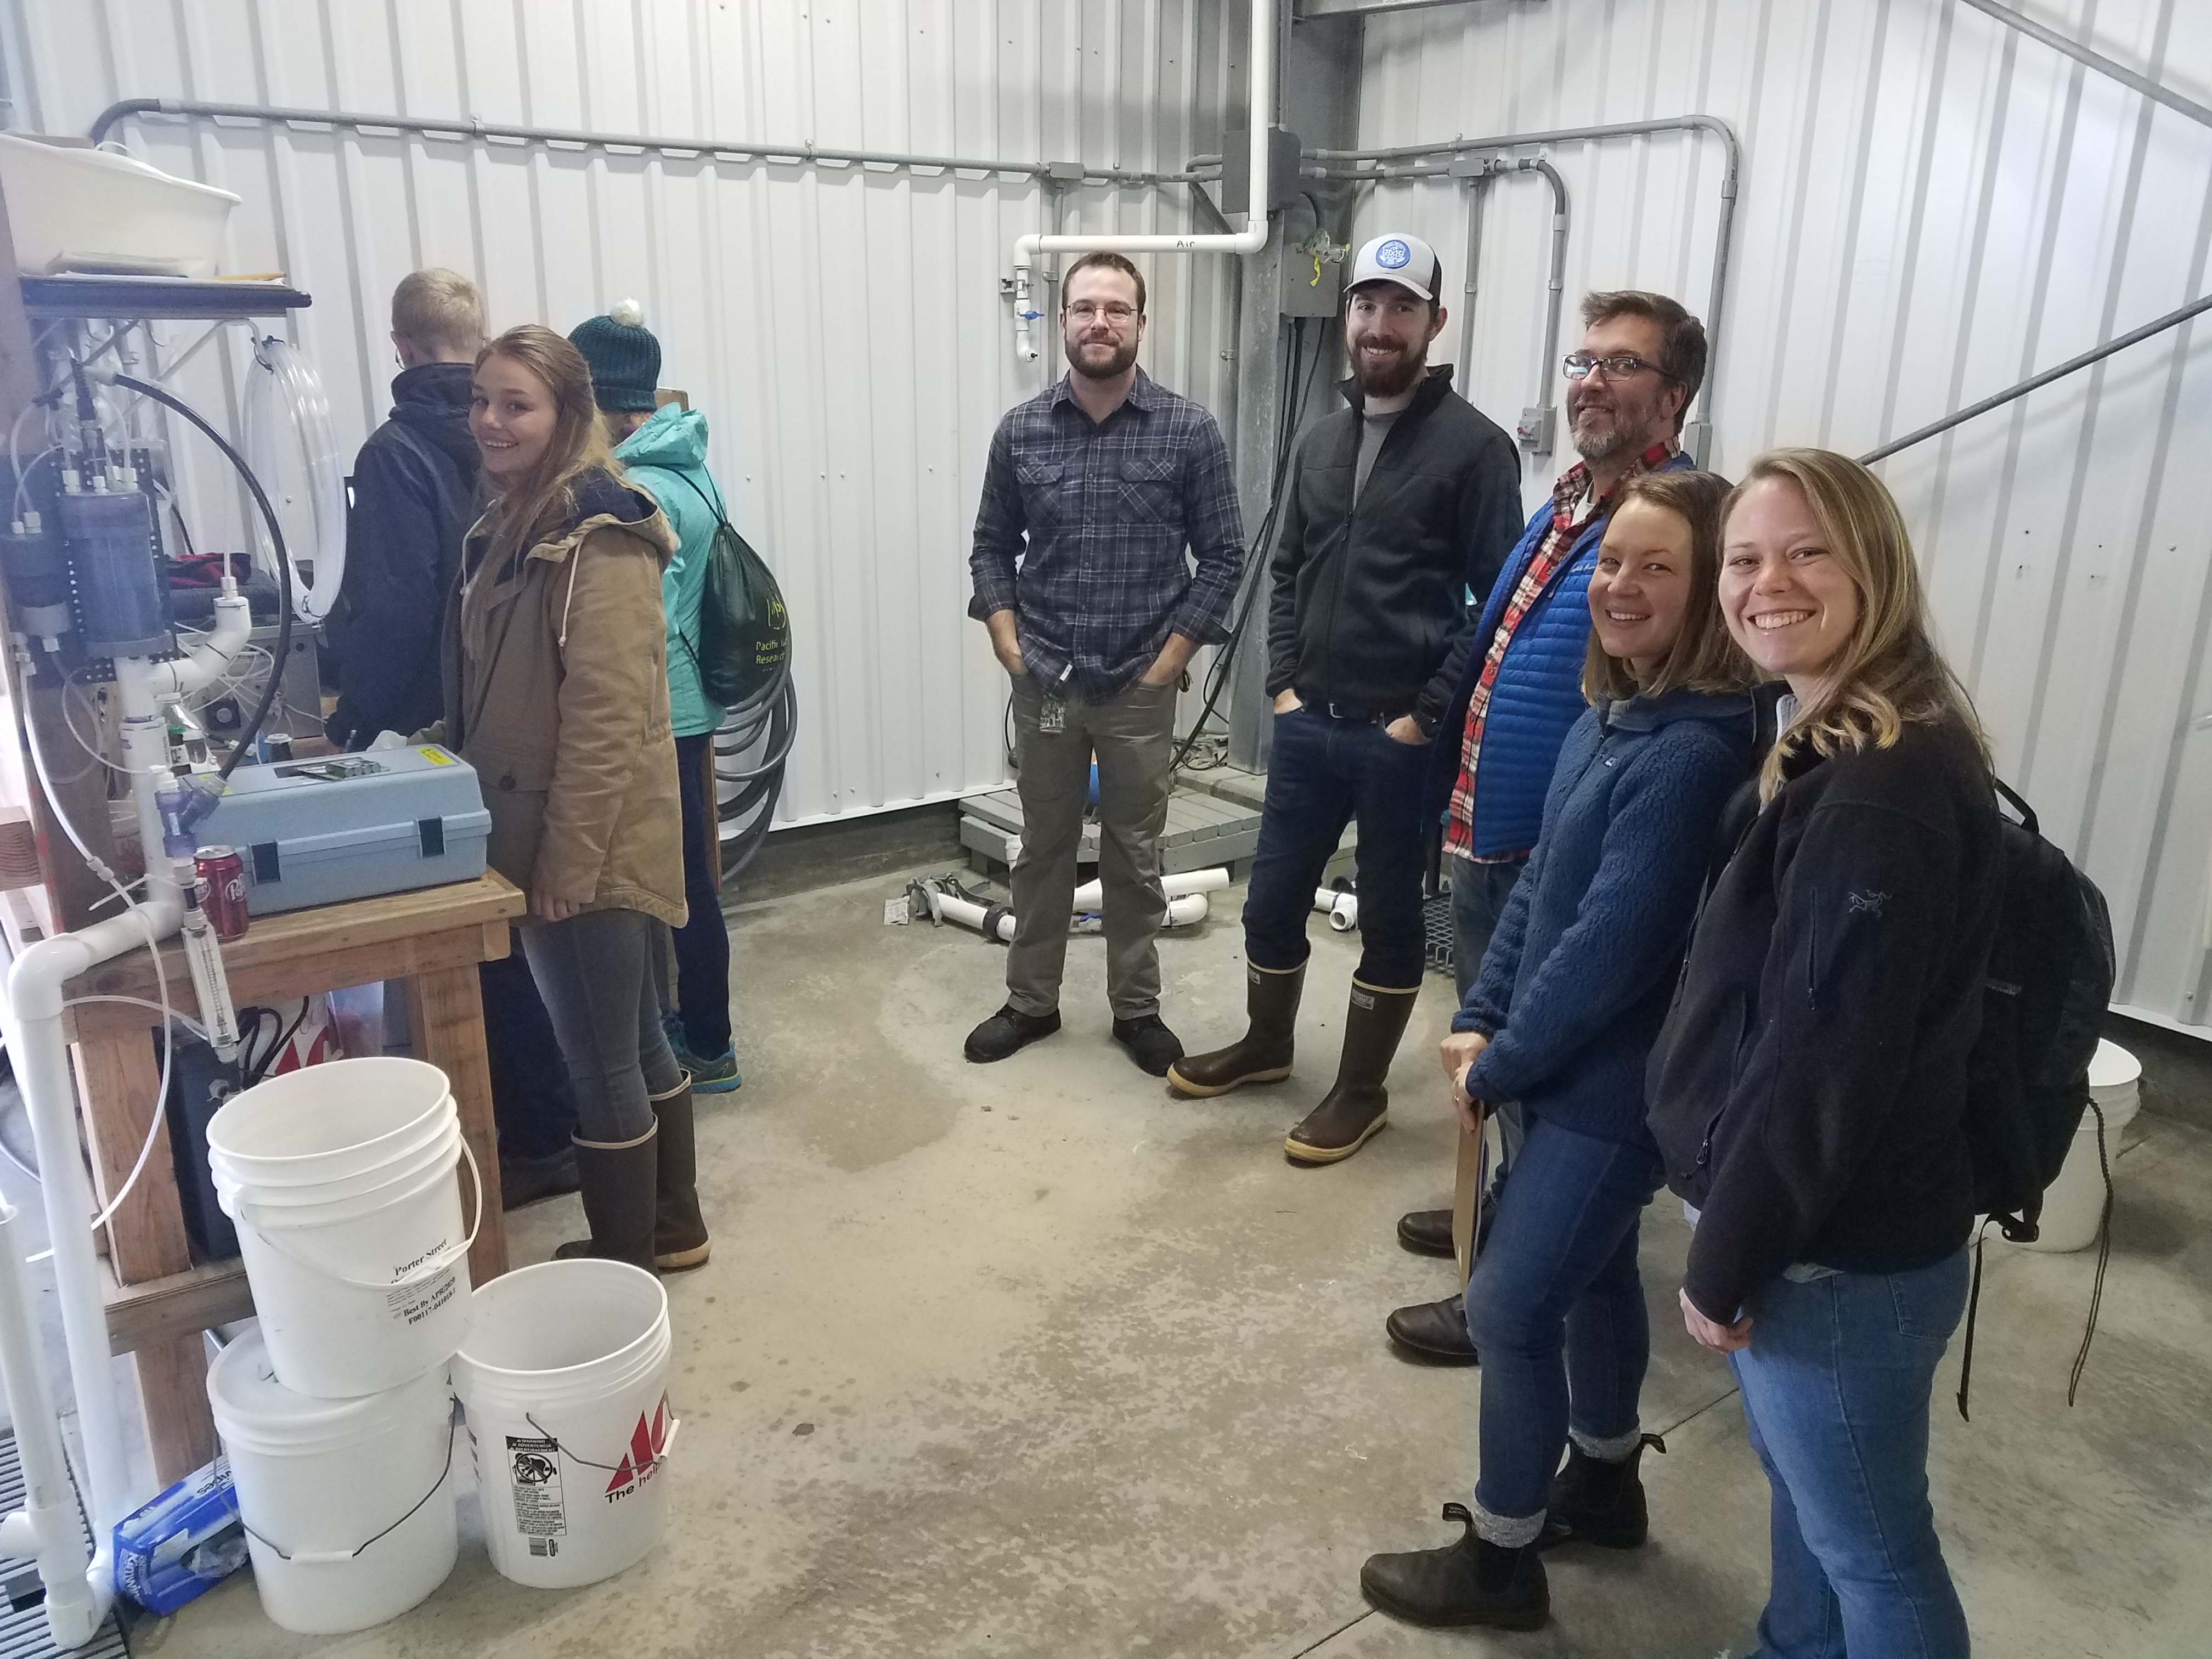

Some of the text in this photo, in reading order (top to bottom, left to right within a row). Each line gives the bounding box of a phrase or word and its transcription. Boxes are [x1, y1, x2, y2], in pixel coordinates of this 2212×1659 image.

[394, 1238, 447, 1276] Porter Street
[403, 1305, 419, 1317] Best
[420, 1300, 429, 1308] By
[605, 1462, 663, 1504] The help
